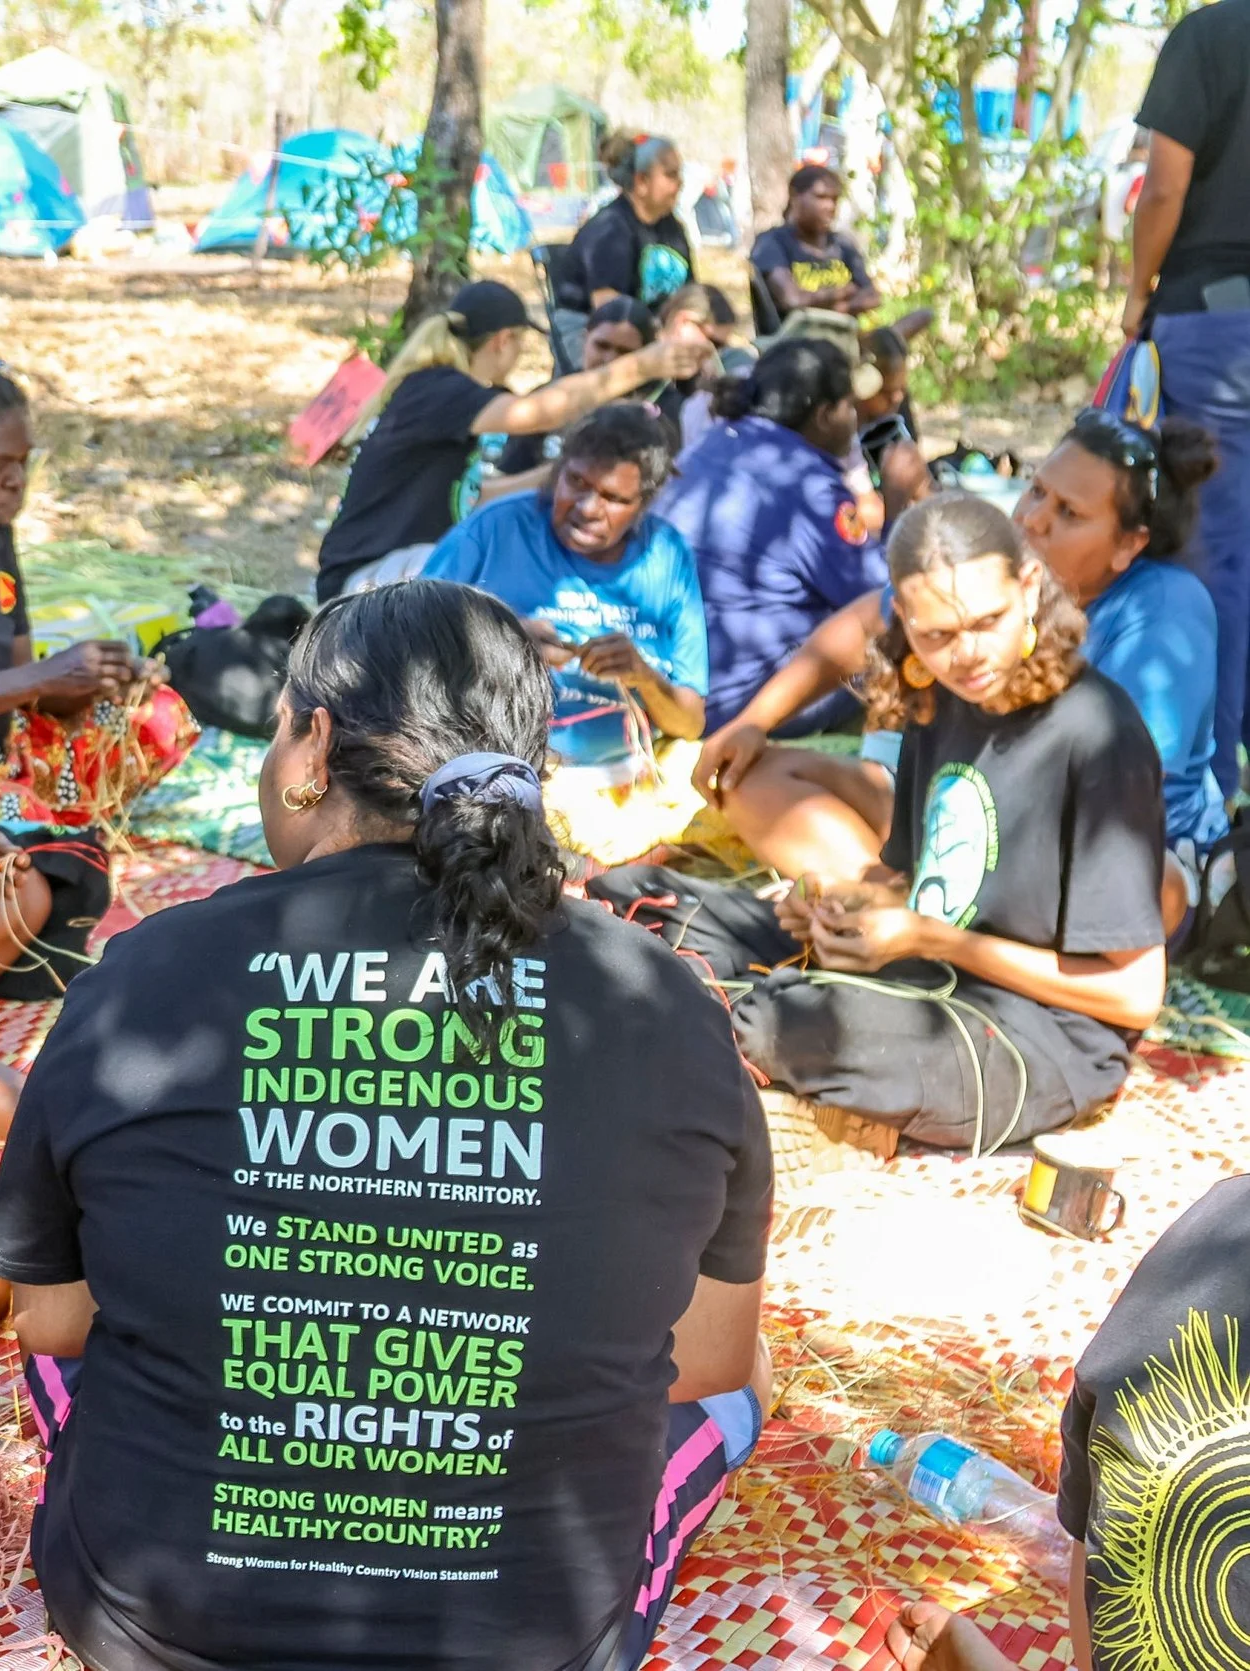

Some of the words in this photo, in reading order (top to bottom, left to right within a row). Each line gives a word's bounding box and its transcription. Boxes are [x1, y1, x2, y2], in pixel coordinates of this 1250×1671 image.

[249, 951, 389, 1002] “WE
[243, 1007, 546, 1068] STRONG
[242, 1067, 544, 1113] INDIGENOUS
[238, 1107, 544, 1181] WOMEN
[233, 1168, 260, 1185] OF
[264, 1171, 304, 1190] THE
[309, 1174, 422, 1198] NORTHERN
[427, 1182, 542, 1206] TERRITORY.
[225, 1214, 267, 1238] We
[276, 1216, 377, 1245] STAND
[387, 1226, 504, 1256] UNITED
[511, 1241, 539, 1259] as
[224, 1244, 289, 1271] ONE
[297, 1250, 424, 1281] STRONG
[433, 1259, 535, 1291] VOICE.
[220, 1294, 255, 1313] WE
[262, 1296, 354, 1319] COMMIT
[359, 1302, 390, 1321] TO
[396, 1305, 413, 1324] A
[418, 1308, 532, 1335] NETWORK
[222, 1318, 361, 1363] THAT
[375, 1327, 525, 1378] GIVES
[223, 1358, 356, 1400] EQUAL
[367, 1368, 519, 1409] POWER
[220, 1412, 244, 1430] to
[248, 1415, 287, 1436] the
[294, 1401, 482, 1451] RIGHTS
[487, 1430, 515, 1450] of
[217, 1433, 274, 1464] ALL
[282, 1441, 356, 1470] OUR
[364, 1447, 508, 1476] WOMEN.
[214, 1482, 315, 1511] STRONG
[324, 1493, 428, 1519] WOMEN
[433, 1503, 503, 1520] means
[211, 1509, 342, 1540] HEALTHY
[206, 1552, 244, 1569] Strong
[245, 1556, 288, 1570] Women
[290, 1559, 307, 1571] for
[309, 1560, 354, 1576] Healthy
[355, 1564, 401, 1580] Country
[402, 1568, 438, 1581] Vision
[440, 1569, 499, 1581] Statement
